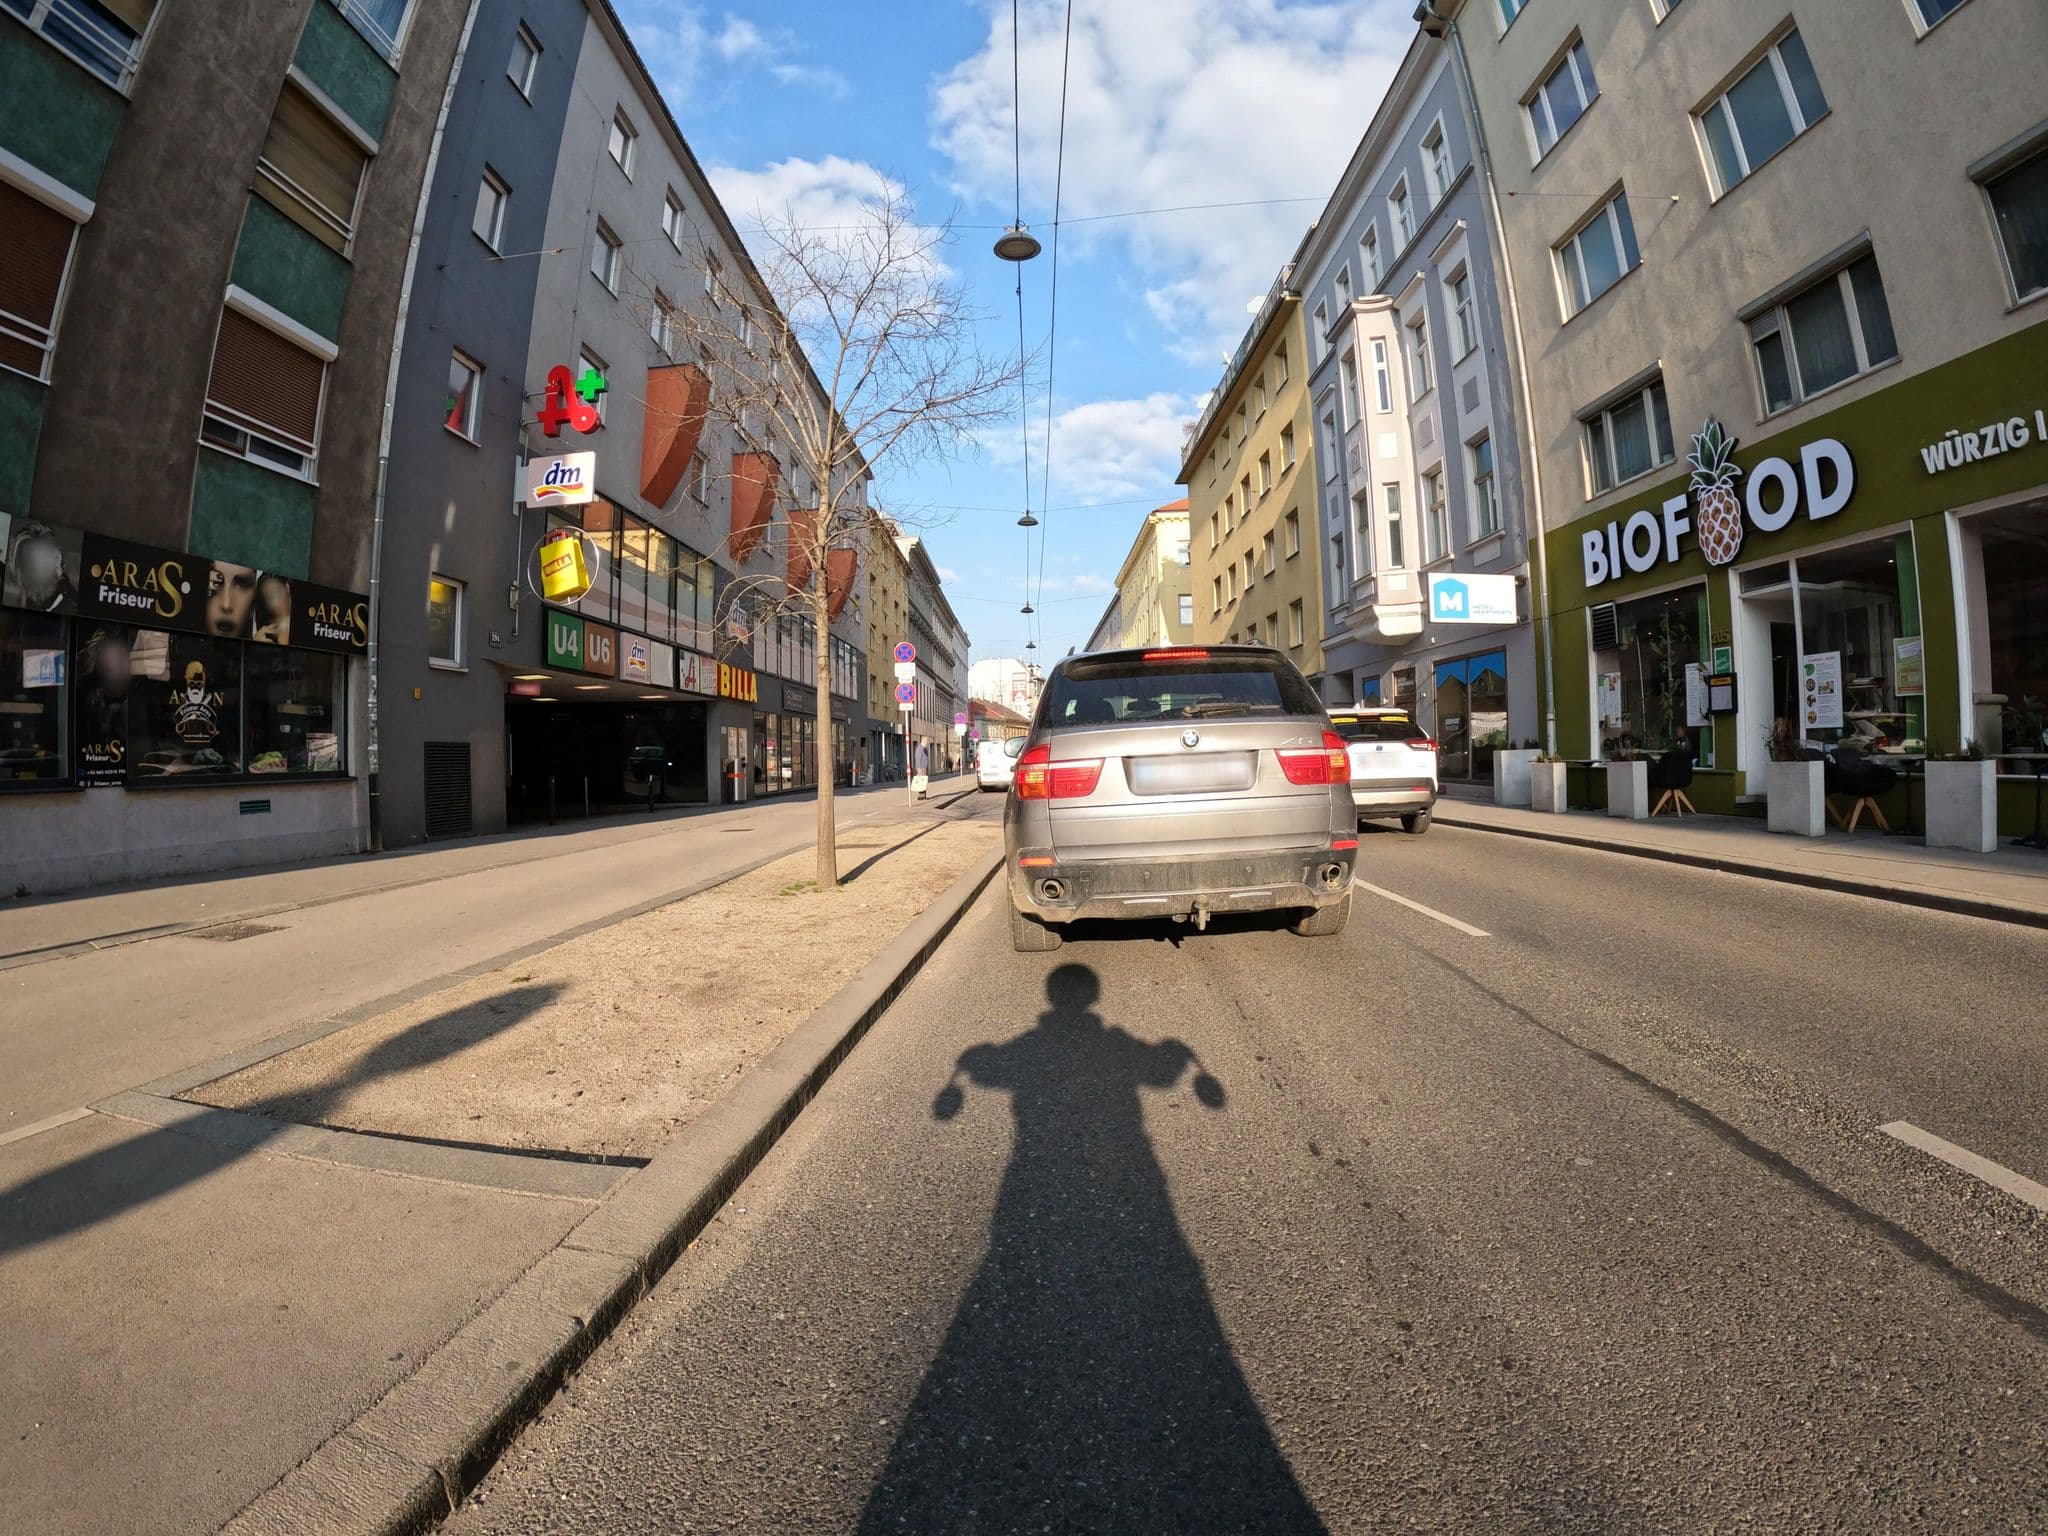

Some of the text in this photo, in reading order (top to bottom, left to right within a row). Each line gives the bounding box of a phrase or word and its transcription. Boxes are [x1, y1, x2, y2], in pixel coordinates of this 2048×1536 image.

[1920, 416, 2030, 475] WÜRZIG
[544, 461, 581, 486] dm
[98, 584, 154, 609] Friseur
[100, 559, 183, 618] ARAS
[1439, 591, 1464, 612] M
[313, 622, 352, 641] Friseur
[315, 601, 369, 647] ARAS
[554, 623, 578, 657] U4
[589, 632, 610, 664] U6
[631, 640, 645, 660] dm
[720, 662, 758, 703] BILLA
